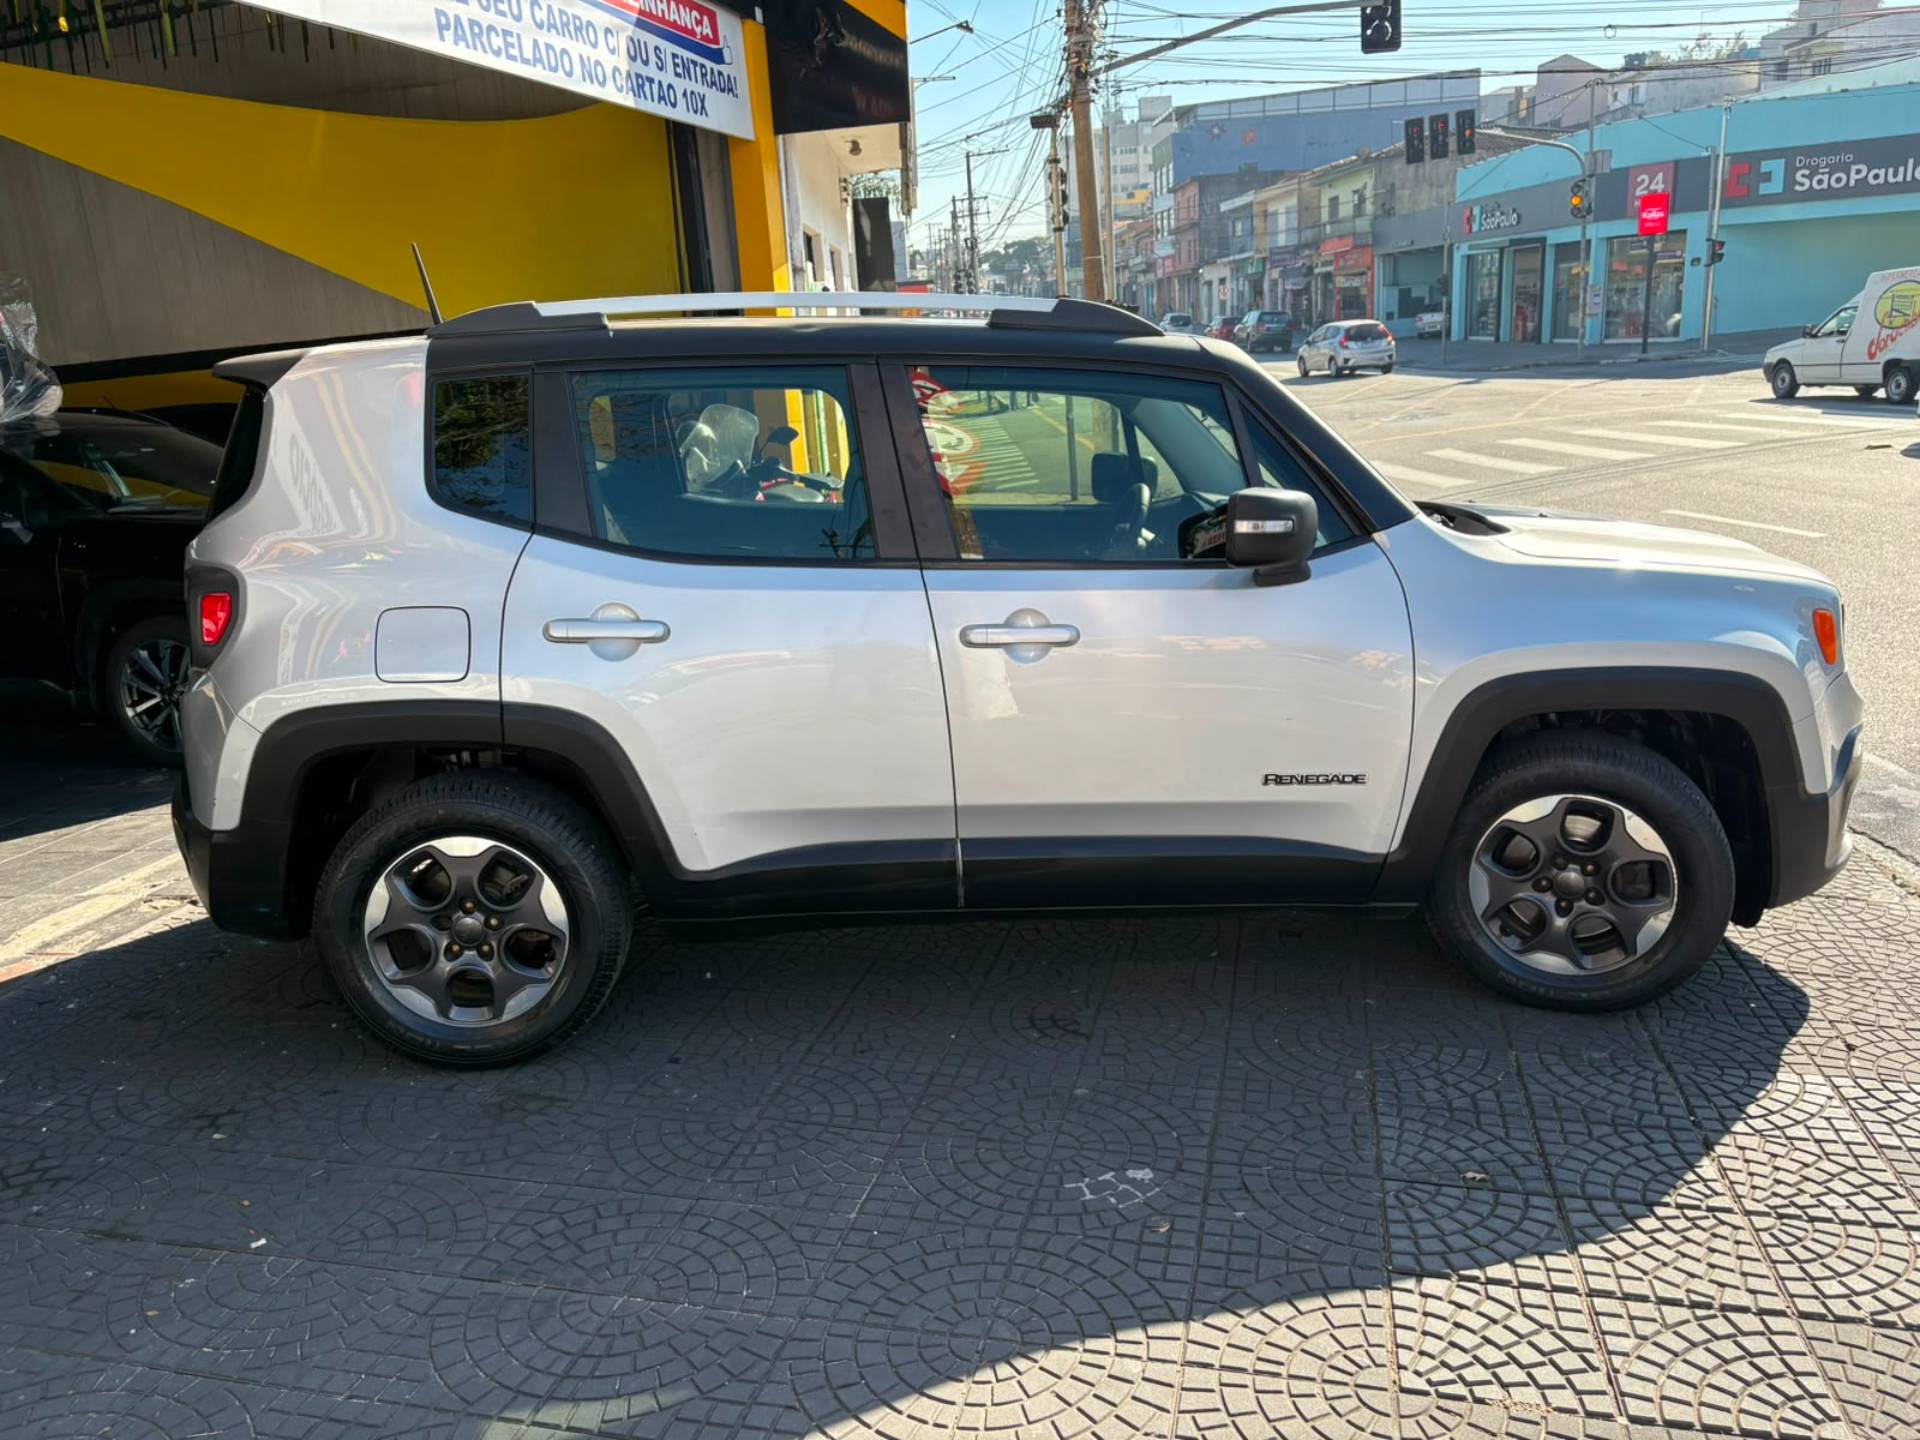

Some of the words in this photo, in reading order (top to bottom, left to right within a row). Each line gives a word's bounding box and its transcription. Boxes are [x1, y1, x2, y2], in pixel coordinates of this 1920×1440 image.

[434, 7, 574, 79] PARCELADO
[579, 53, 607, 88] NO
[682, 88, 709, 117] 10X
[529, 0, 599, 50] CARRO
[626, 35, 650, 67] OU
[671, 52, 739, 99] ENTRADA!
[1795, 153, 1854, 168] Drogaria
[1635, 171, 1665, 197] 24
[1262, 773, 1367, 786] RENEGADE
